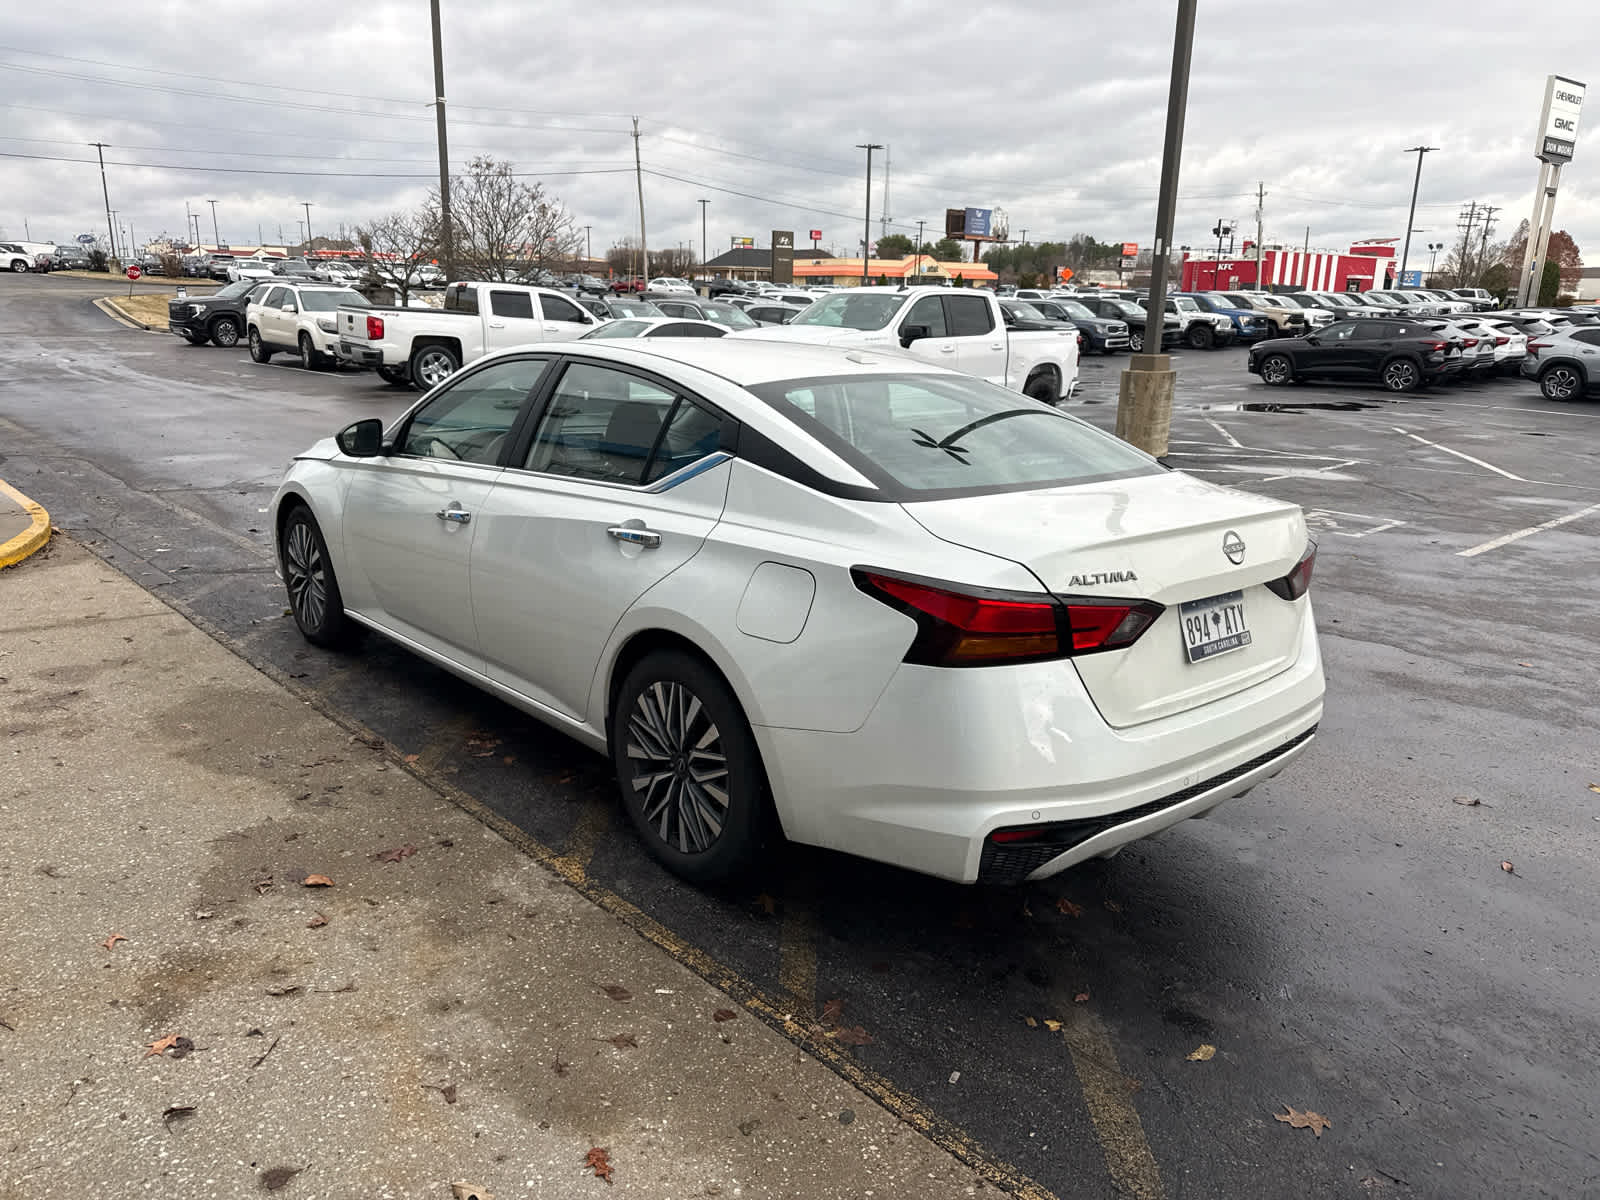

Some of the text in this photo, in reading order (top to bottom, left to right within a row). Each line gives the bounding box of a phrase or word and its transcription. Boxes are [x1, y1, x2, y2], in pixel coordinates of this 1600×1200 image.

[1554, 117, 1575, 132] GMC
[1217, 263, 1234, 271] KFC
[1068, 570, 1138, 587] ALTIMA
[1186, 603, 1246, 646] 894 ATY
[1217, 637, 1239, 650] CAROLINA
